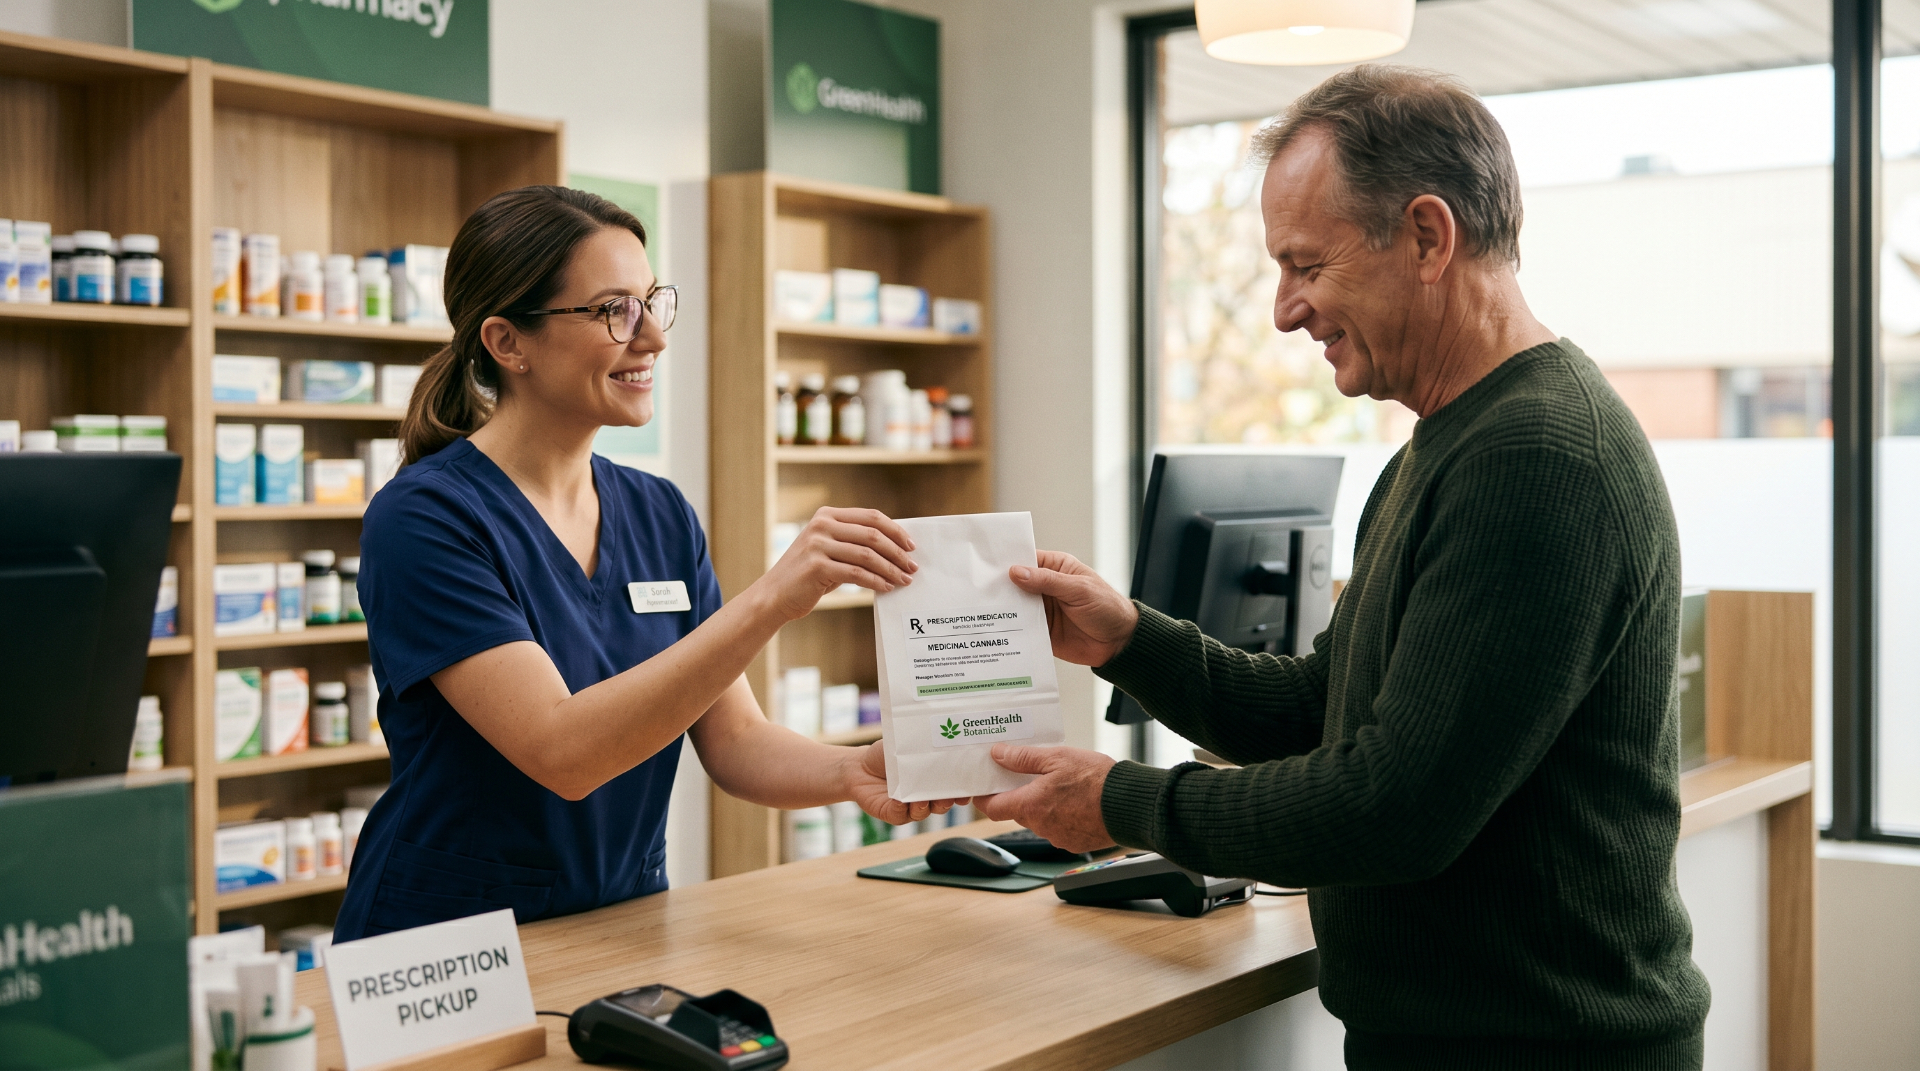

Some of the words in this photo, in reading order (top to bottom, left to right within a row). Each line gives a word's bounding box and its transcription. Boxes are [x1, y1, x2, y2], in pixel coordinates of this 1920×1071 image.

[651, 586, 671, 596] Sarah
[927, 615, 976, 625] PRESCRIPTION
[977, 612, 1018, 621] MEDICATION
[928, 641, 969, 651] MEDICINAL
[970, 638, 1009, 648] CANNABIS
[963, 713, 1022, 727] GreenHealth
[964, 725, 1006, 737] Botanicals
[0, 905, 133, 970] Health
[348, 946, 509, 1001] PRESCRIPTION
[398, 988, 478, 1025] PICKUP
